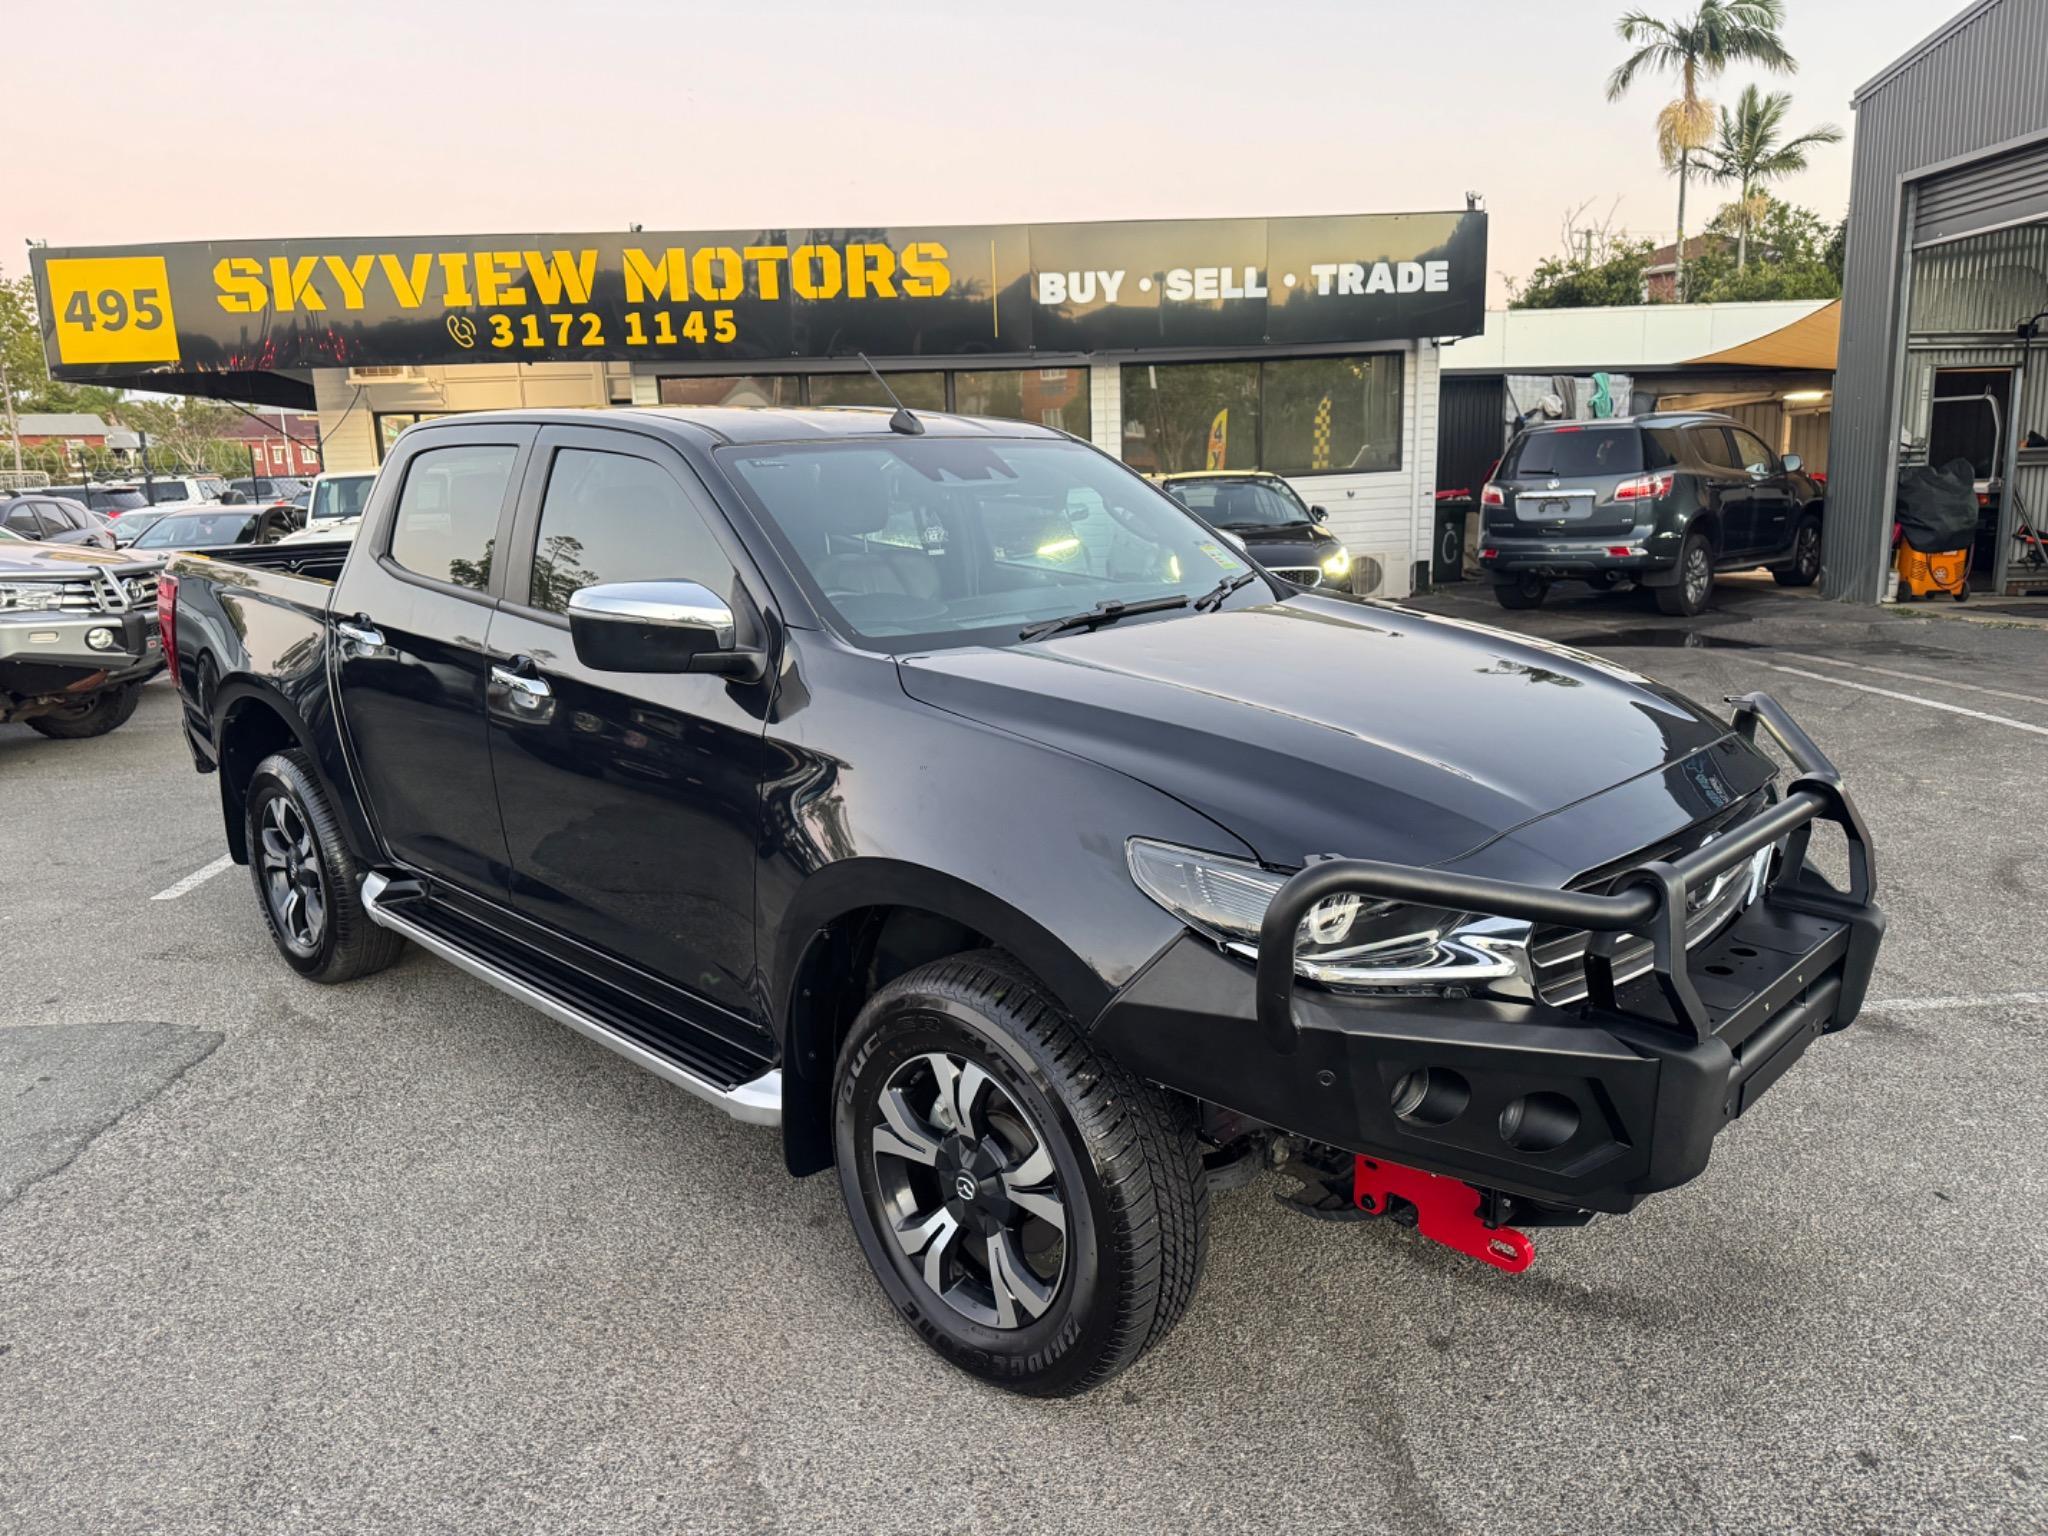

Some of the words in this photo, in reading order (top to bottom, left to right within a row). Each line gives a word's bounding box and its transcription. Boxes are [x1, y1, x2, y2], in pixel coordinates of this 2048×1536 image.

[212, 247, 599, 313] SKYVIEW
[622, 241, 953, 303] MOTORS
[1039, 270, 1126, 305] BUY
[1165, 266, 1268, 301] SELL
[1310, 260, 1450, 296] TRADE
[63, 287, 163, 332] 495
[489, 312, 606, 348] 3172
[624, 309, 738, 346] 1145
